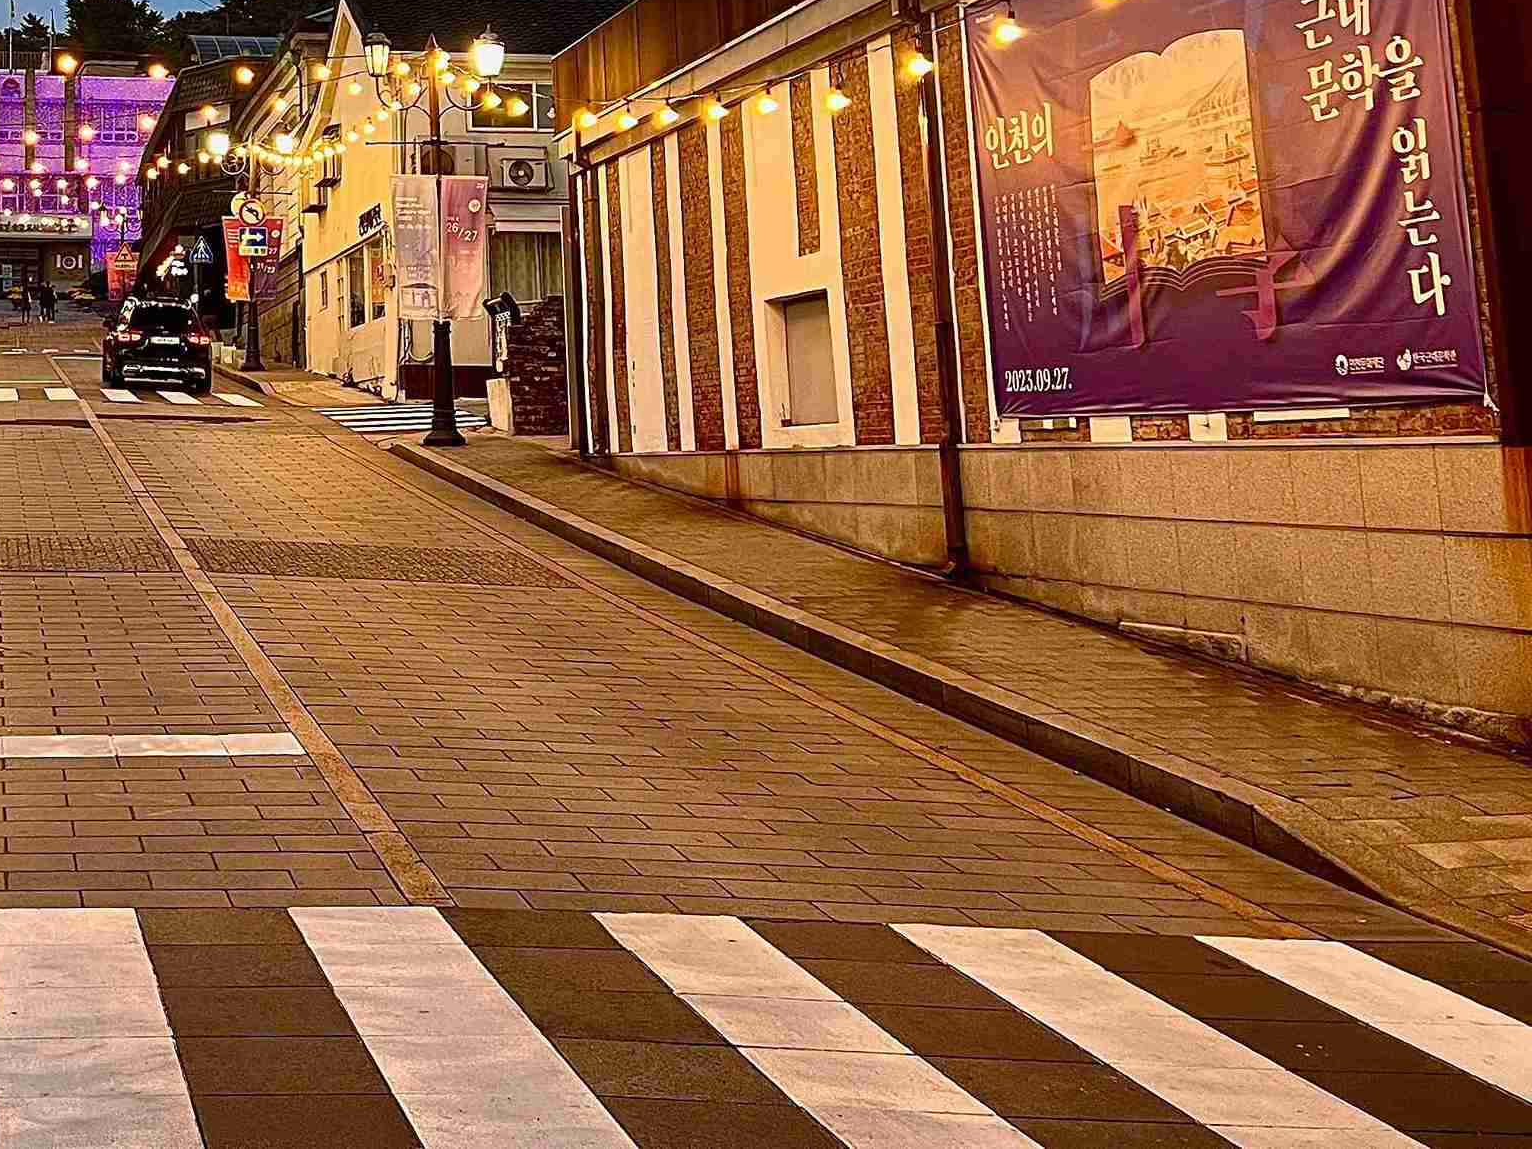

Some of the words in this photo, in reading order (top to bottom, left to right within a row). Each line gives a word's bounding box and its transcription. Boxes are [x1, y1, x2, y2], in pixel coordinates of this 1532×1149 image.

[1302, 35, 1425, 122] 문학을
[985, 102, 1053, 170] 인천의
[1391, 118, 1452, 316] 읽는다
[1004, 367, 1073, 392] 2023.09.27.
